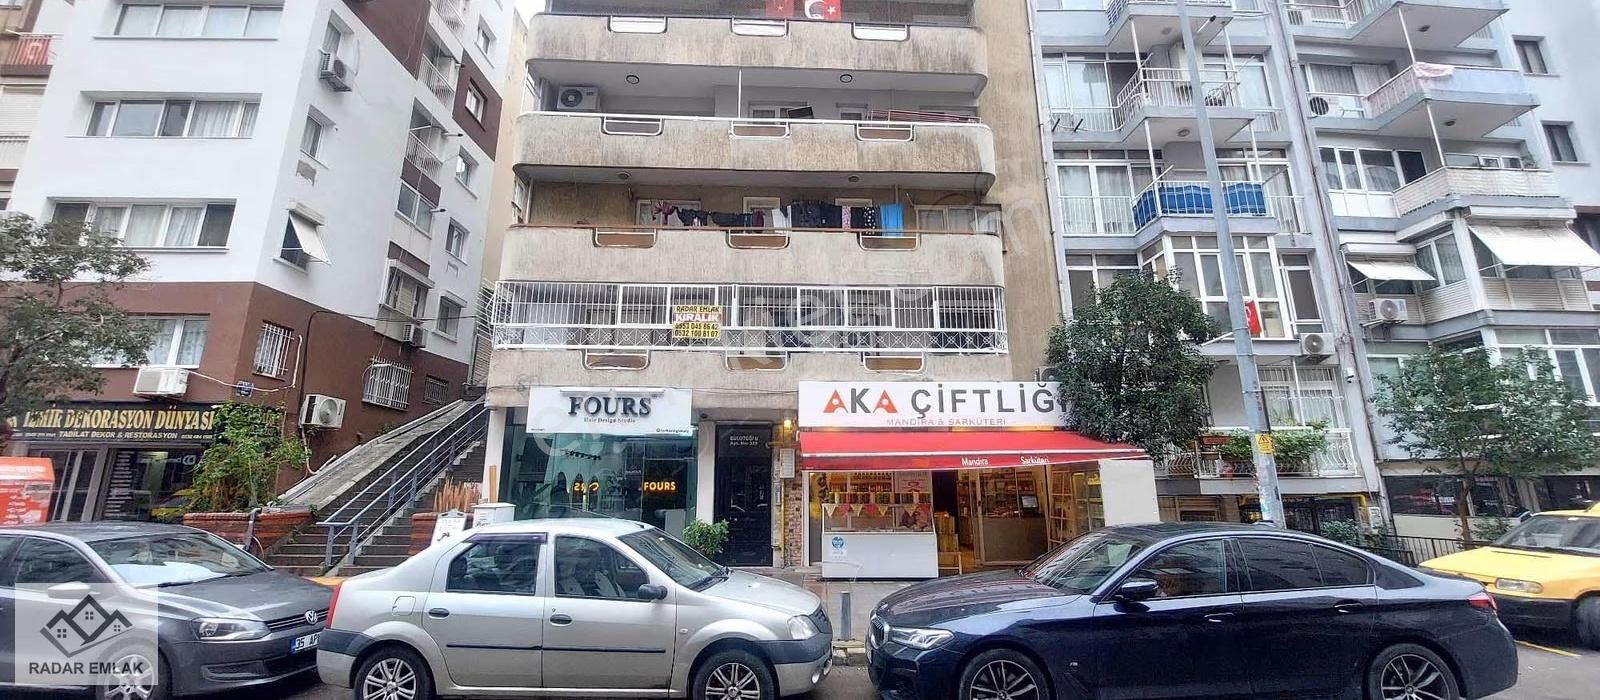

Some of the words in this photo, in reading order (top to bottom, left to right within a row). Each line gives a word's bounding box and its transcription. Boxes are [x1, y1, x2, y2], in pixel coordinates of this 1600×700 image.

[675, 313, 719, 322] KIRALIK
[568, 396, 651, 416] FOURS
[823, 388, 898, 413] AKA
[64, 408, 152, 429] DEKORASYON
[155, 405, 214, 430] DÜNYASI
[644, 482, 676, 490] FOURS
[296, 638, 306, 649] 35
